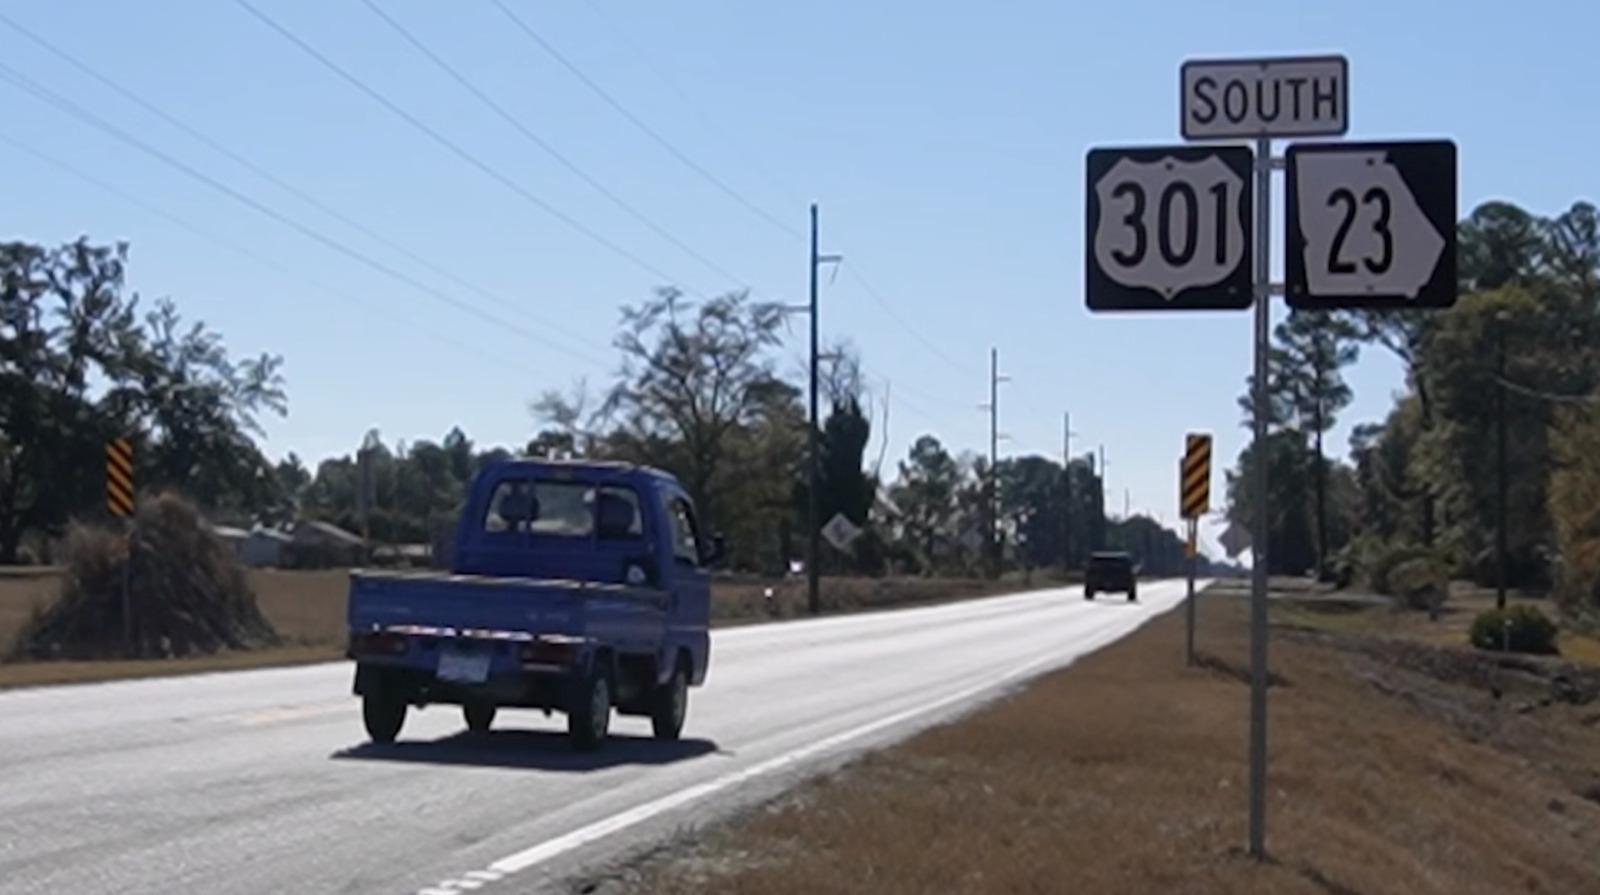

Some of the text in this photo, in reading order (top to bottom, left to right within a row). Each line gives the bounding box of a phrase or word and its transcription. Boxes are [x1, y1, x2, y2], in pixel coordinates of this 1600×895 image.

[1192, 76, 1338, 124] SOUTH
[1110, 180, 1228, 267] 301
[1326, 186, 1393, 275] 23
